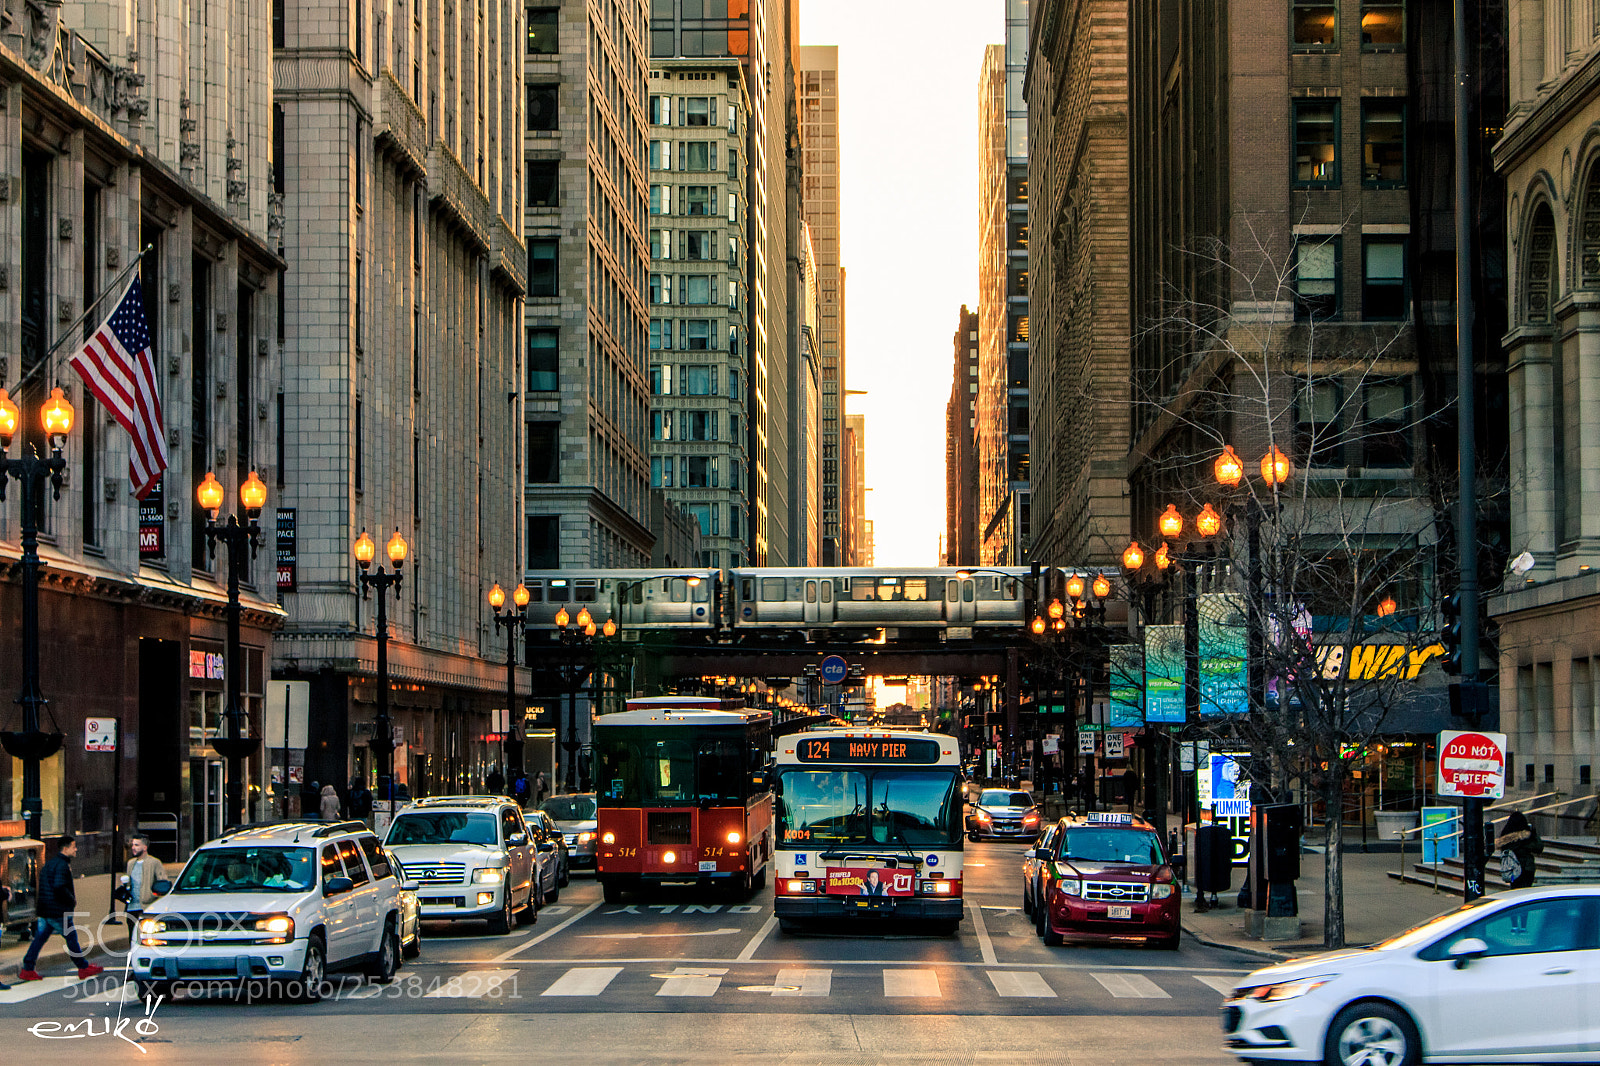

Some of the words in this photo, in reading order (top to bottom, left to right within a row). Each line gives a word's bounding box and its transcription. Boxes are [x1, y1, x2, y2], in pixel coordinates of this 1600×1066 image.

[277, 512, 294, 520] RIME
[277, 521, 295, 529] FFICE
[277, 530, 295, 538] PACE
[825, 664, 843, 674] cta
[807, 741, 831, 759] 124
[850, 743, 878, 757] NAVY
[882, 743, 907, 758] PIER
[1450, 744, 1466, 756] DO
[1471, 745, 1495, 757] NOT
[1211, 800, 1251, 815] MUMMIE
[619, 847, 637, 857] 514
[704, 847, 724, 857] 514
